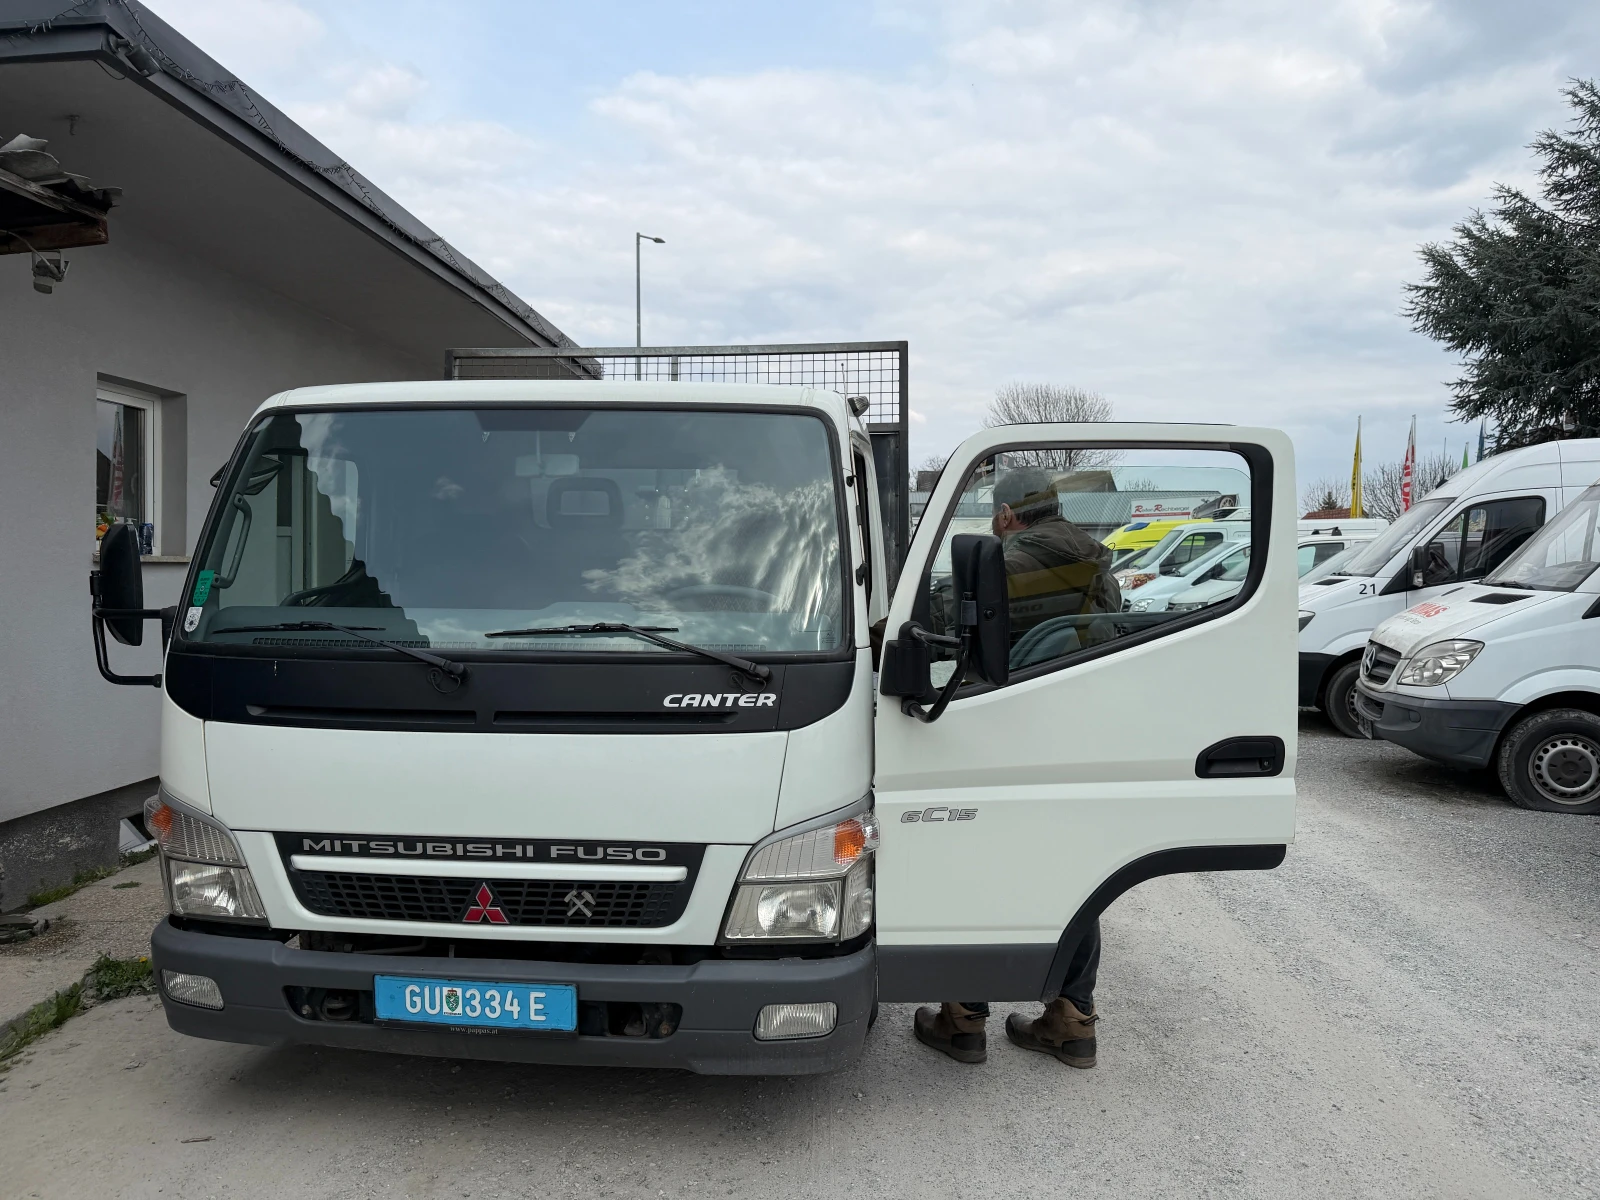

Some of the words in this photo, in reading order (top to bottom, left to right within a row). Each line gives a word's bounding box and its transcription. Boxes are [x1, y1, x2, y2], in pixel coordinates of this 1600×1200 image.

[1358, 583, 1377, 595] 21
[662, 692, 778, 708] CANTER
[899, 806, 979, 824] 6C15
[301, 838, 535, 857] MITSUBISHI
[549, 845, 668, 861] FUSO
[404, 984, 441, 1015] GU
[464, 988, 521, 1020] 334
[528, 991, 547, 1021] E
[450, 1026, 498, 1035] www.pappas.at
